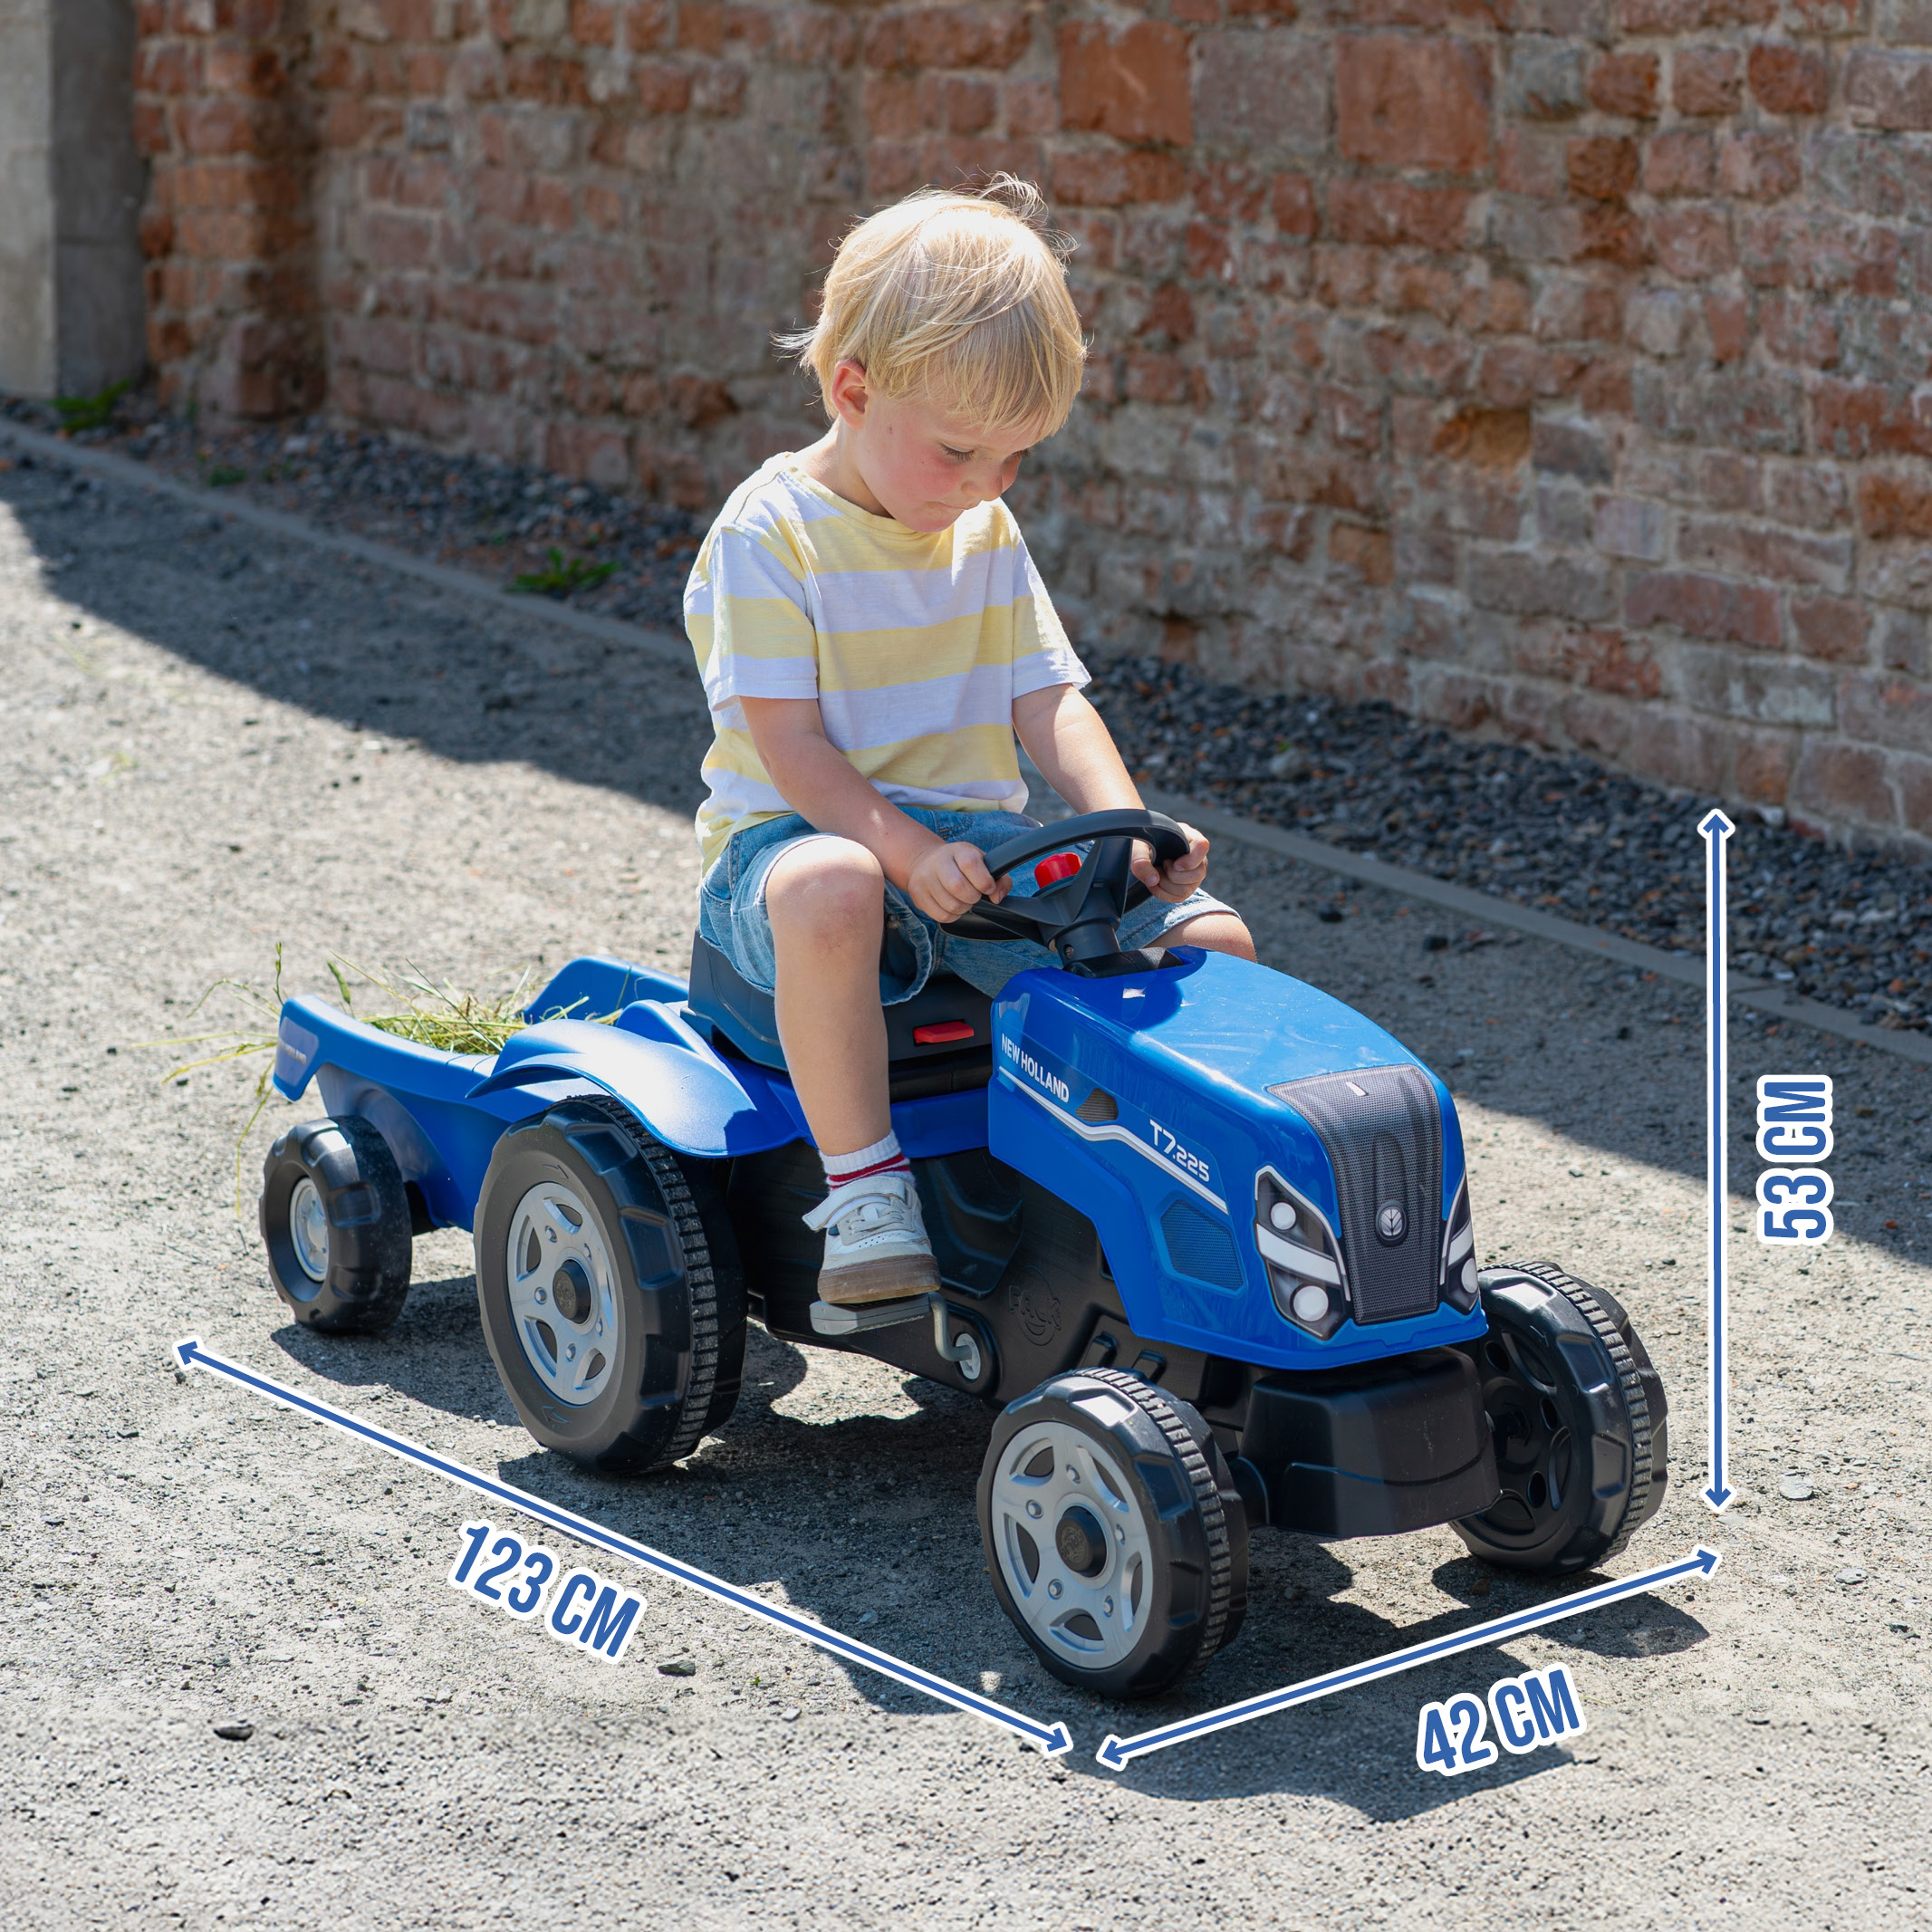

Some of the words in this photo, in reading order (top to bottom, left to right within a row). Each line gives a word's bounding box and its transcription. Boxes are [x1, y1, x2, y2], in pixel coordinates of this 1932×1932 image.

[1001, 1033, 1020, 1064] NEW
[1021, 1053, 1070, 1103] HOLLAND
[1149, 1118, 1210, 1182] T7.225
[1007, 1283, 1062, 1331] FALK
